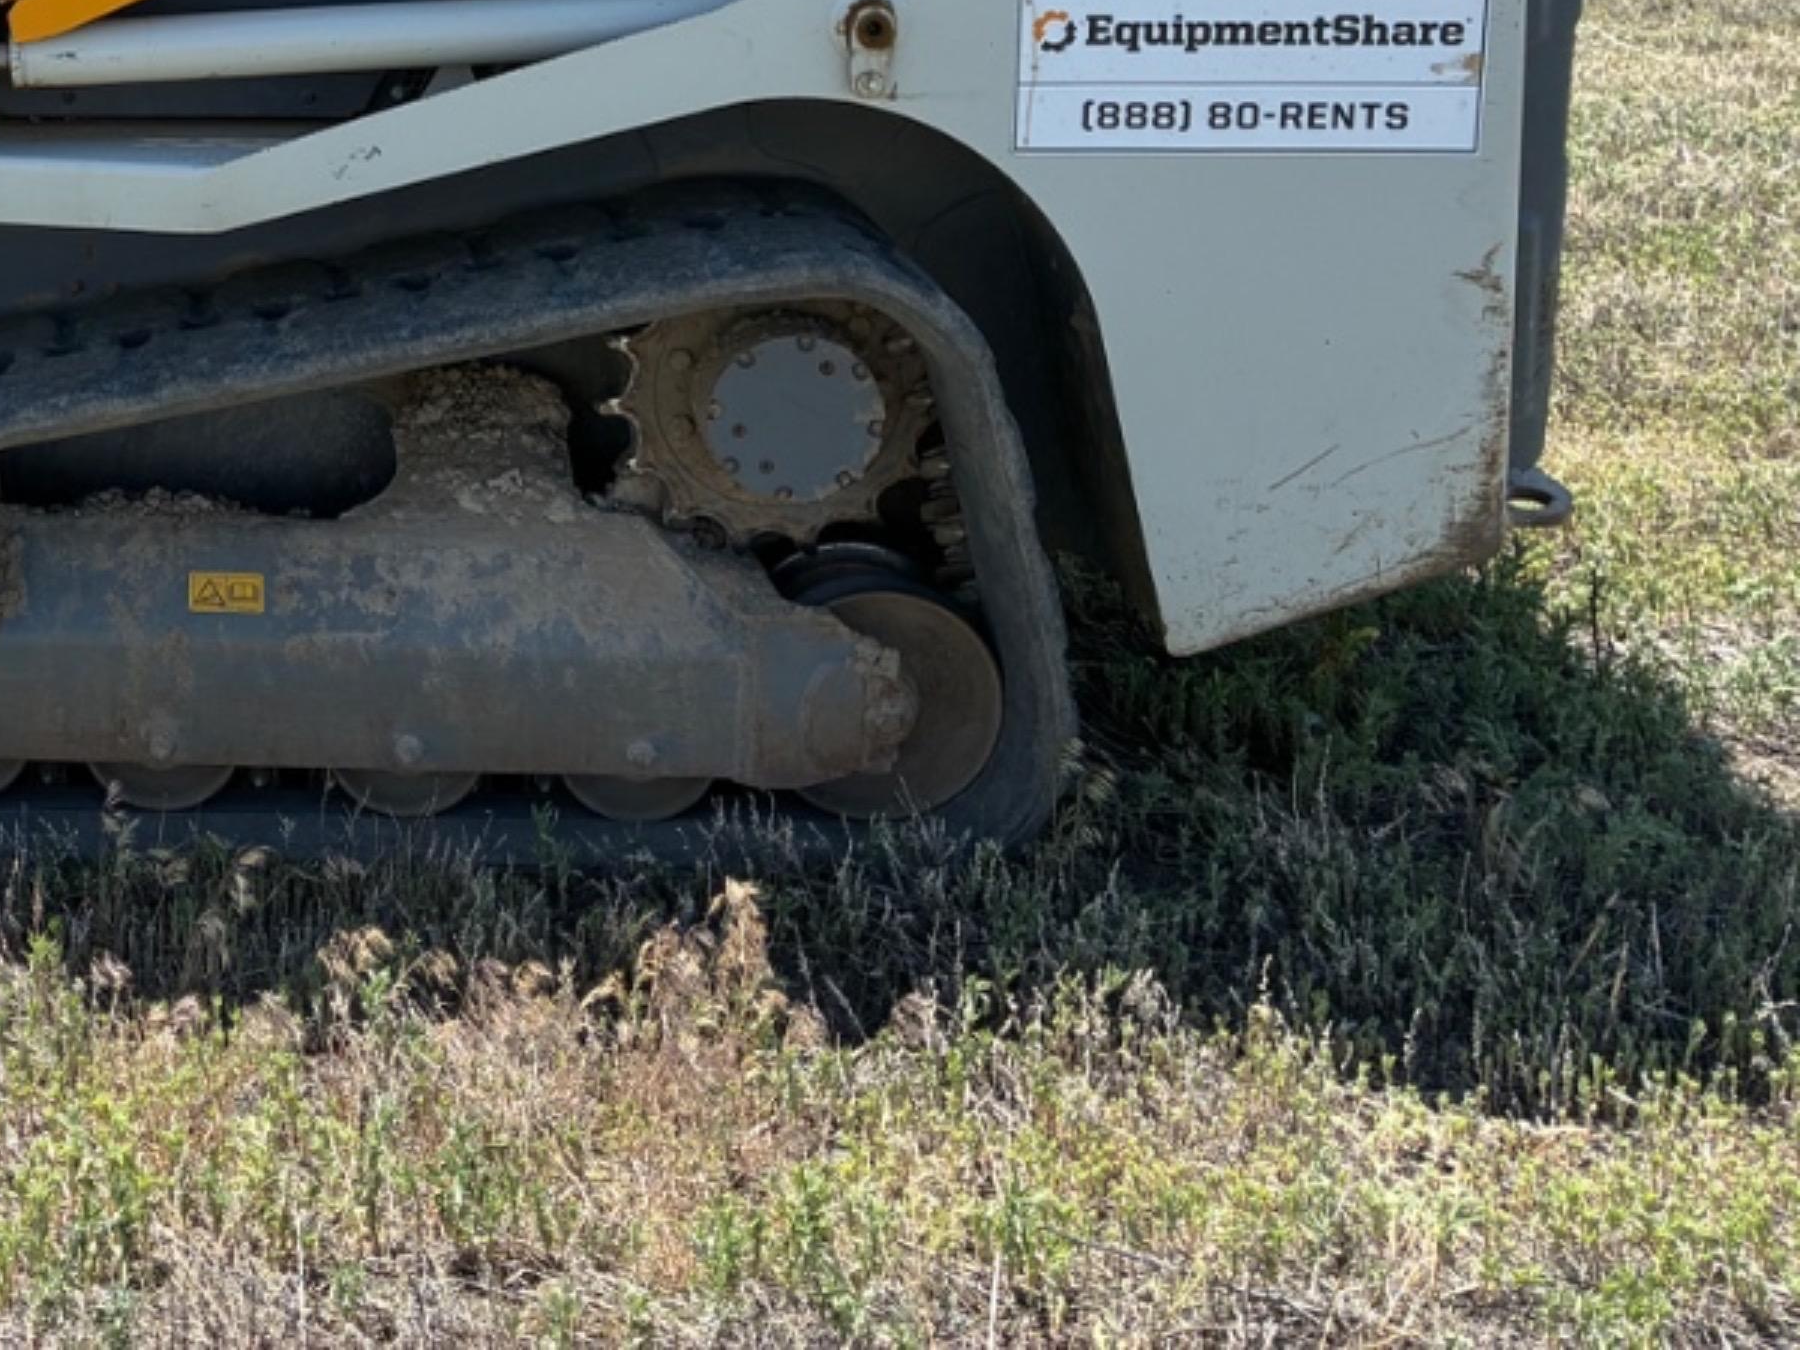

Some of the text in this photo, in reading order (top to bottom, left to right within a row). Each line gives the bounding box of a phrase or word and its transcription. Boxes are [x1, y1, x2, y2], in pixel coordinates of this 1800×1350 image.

[1085, 14, 1464, 52] EquipmentShare
[1081, 100, 1410, 131] (888) 80-RENTS
